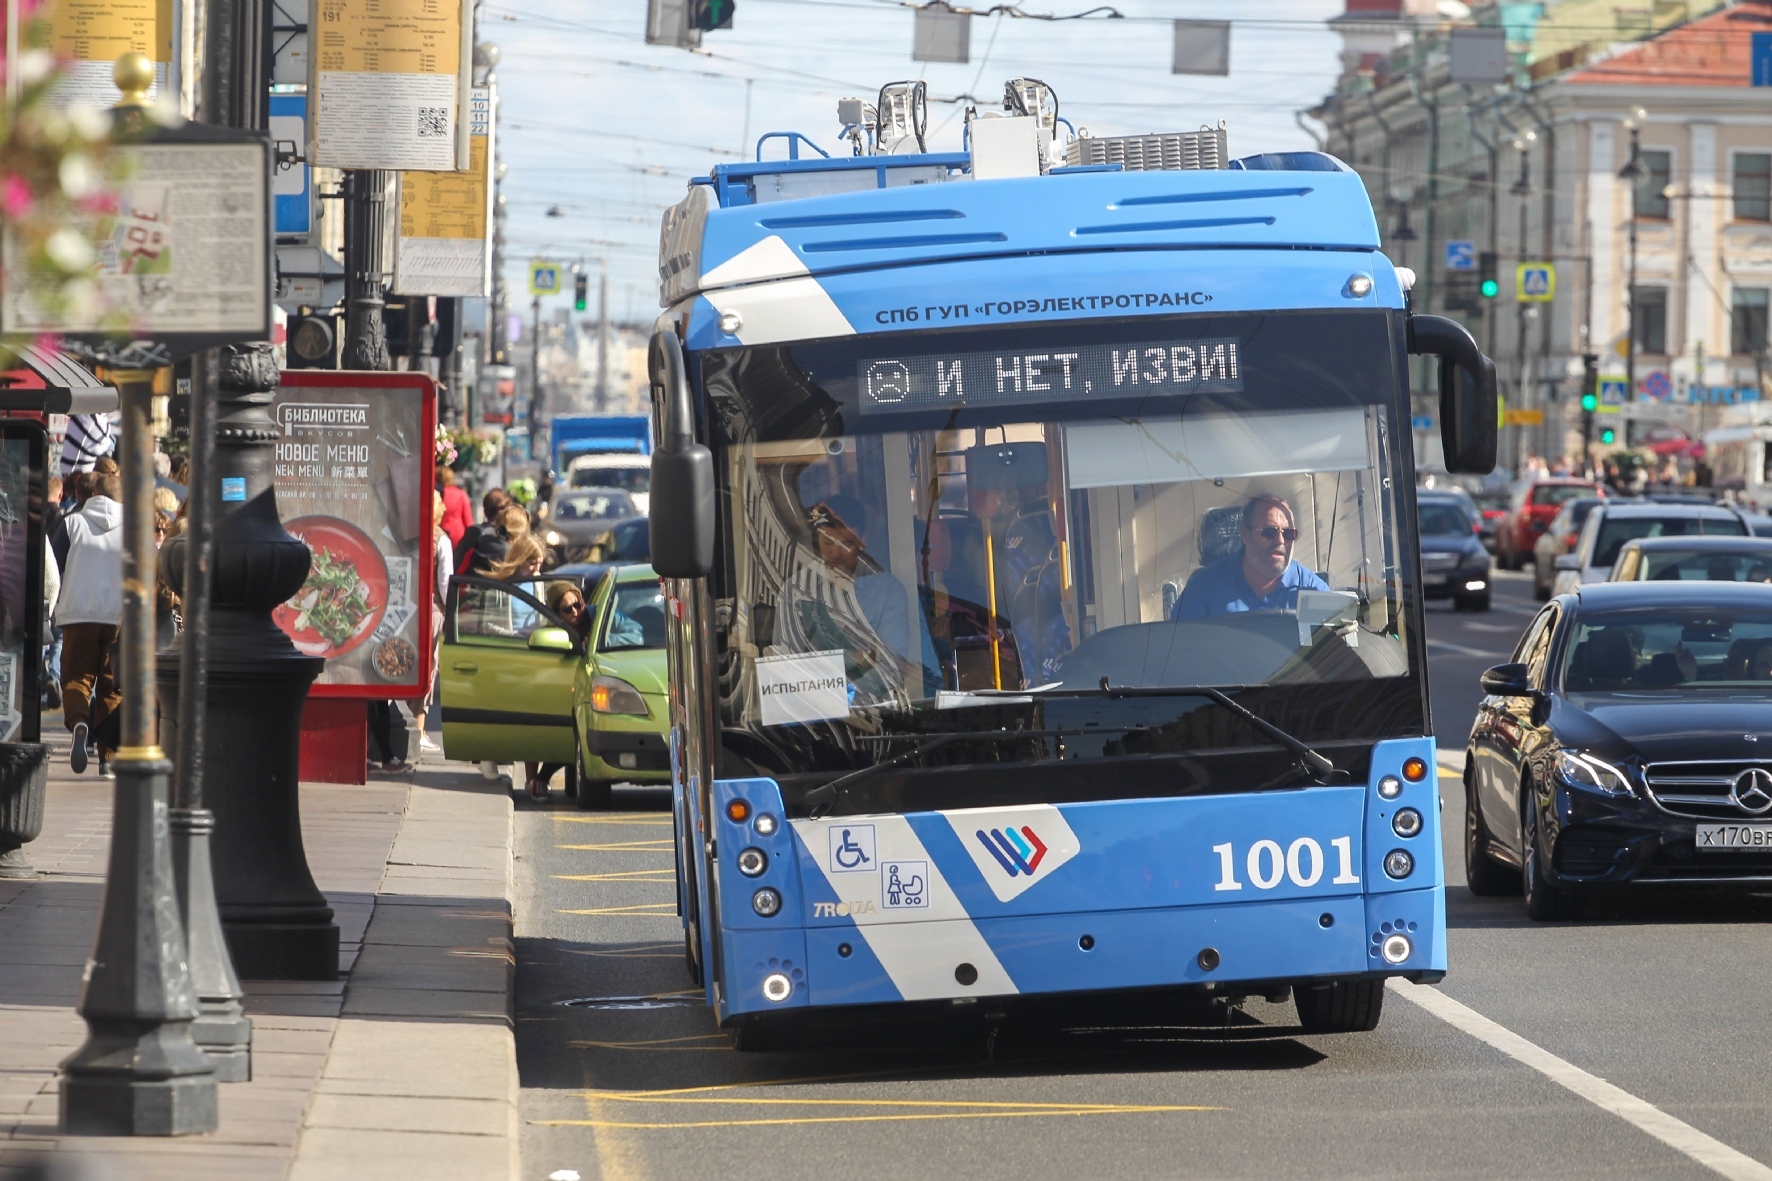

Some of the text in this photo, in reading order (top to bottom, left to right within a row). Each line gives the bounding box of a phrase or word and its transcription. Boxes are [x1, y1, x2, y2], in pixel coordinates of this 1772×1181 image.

[322, 12, 341, 22] 191
[473, 101, 484, 110] 10
[473, 113, 484, 121] 11
[472, 124, 484, 133] 22
[875, 291, 1213, 325] СПб ГУП «ГОРЭЛЕКТРОТРАНС»
[937, 360, 963, 396] И
[996, 353, 1092, 394] НЕТ,
[285, 408, 366, 423] БИБЛИОТЕКА
[275, 443, 369, 463] НОВОЕ МЕНЮ
[275, 465, 369, 479] NEW MENU 新菜單
[761, 677, 845, 696] ИСПЫТАНИЯ
[1212, 835, 1360, 891] 1001
